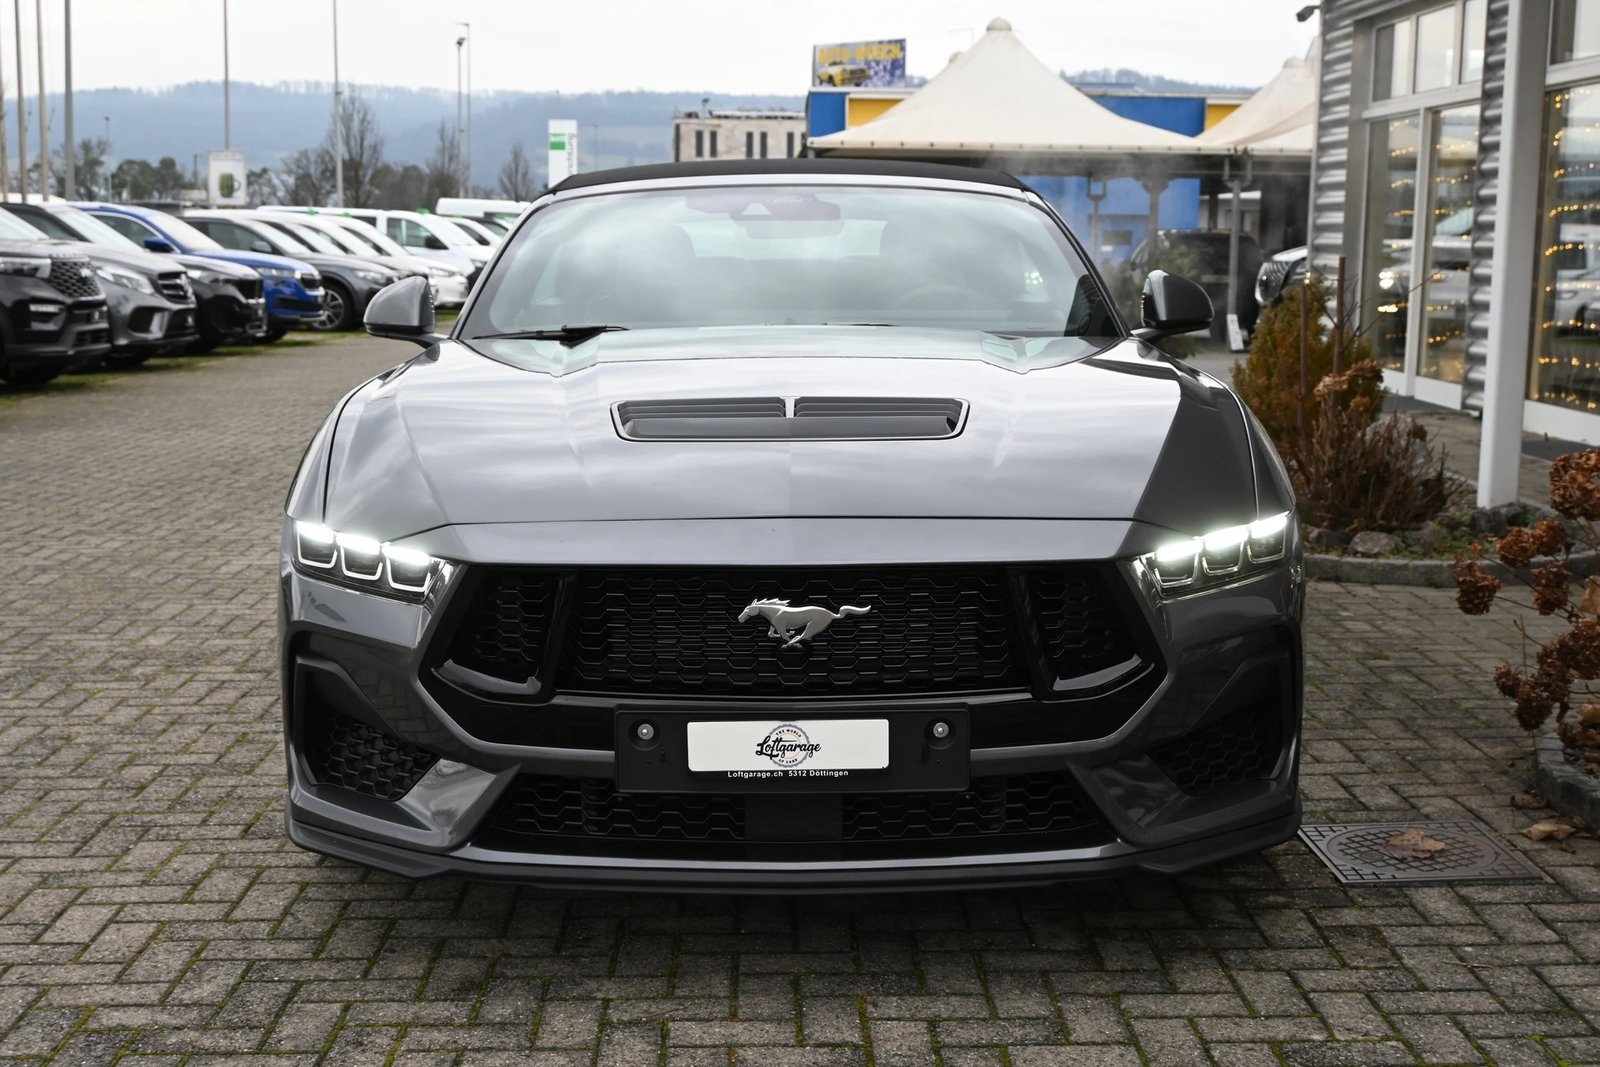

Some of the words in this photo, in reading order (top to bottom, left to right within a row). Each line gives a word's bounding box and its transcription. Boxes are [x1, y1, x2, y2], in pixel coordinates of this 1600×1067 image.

[755, 735, 822, 761] Loftgarage
[727, 770, 784, 779] Loftgarage.ch
[809, 769, 849, 778] Döttingen
